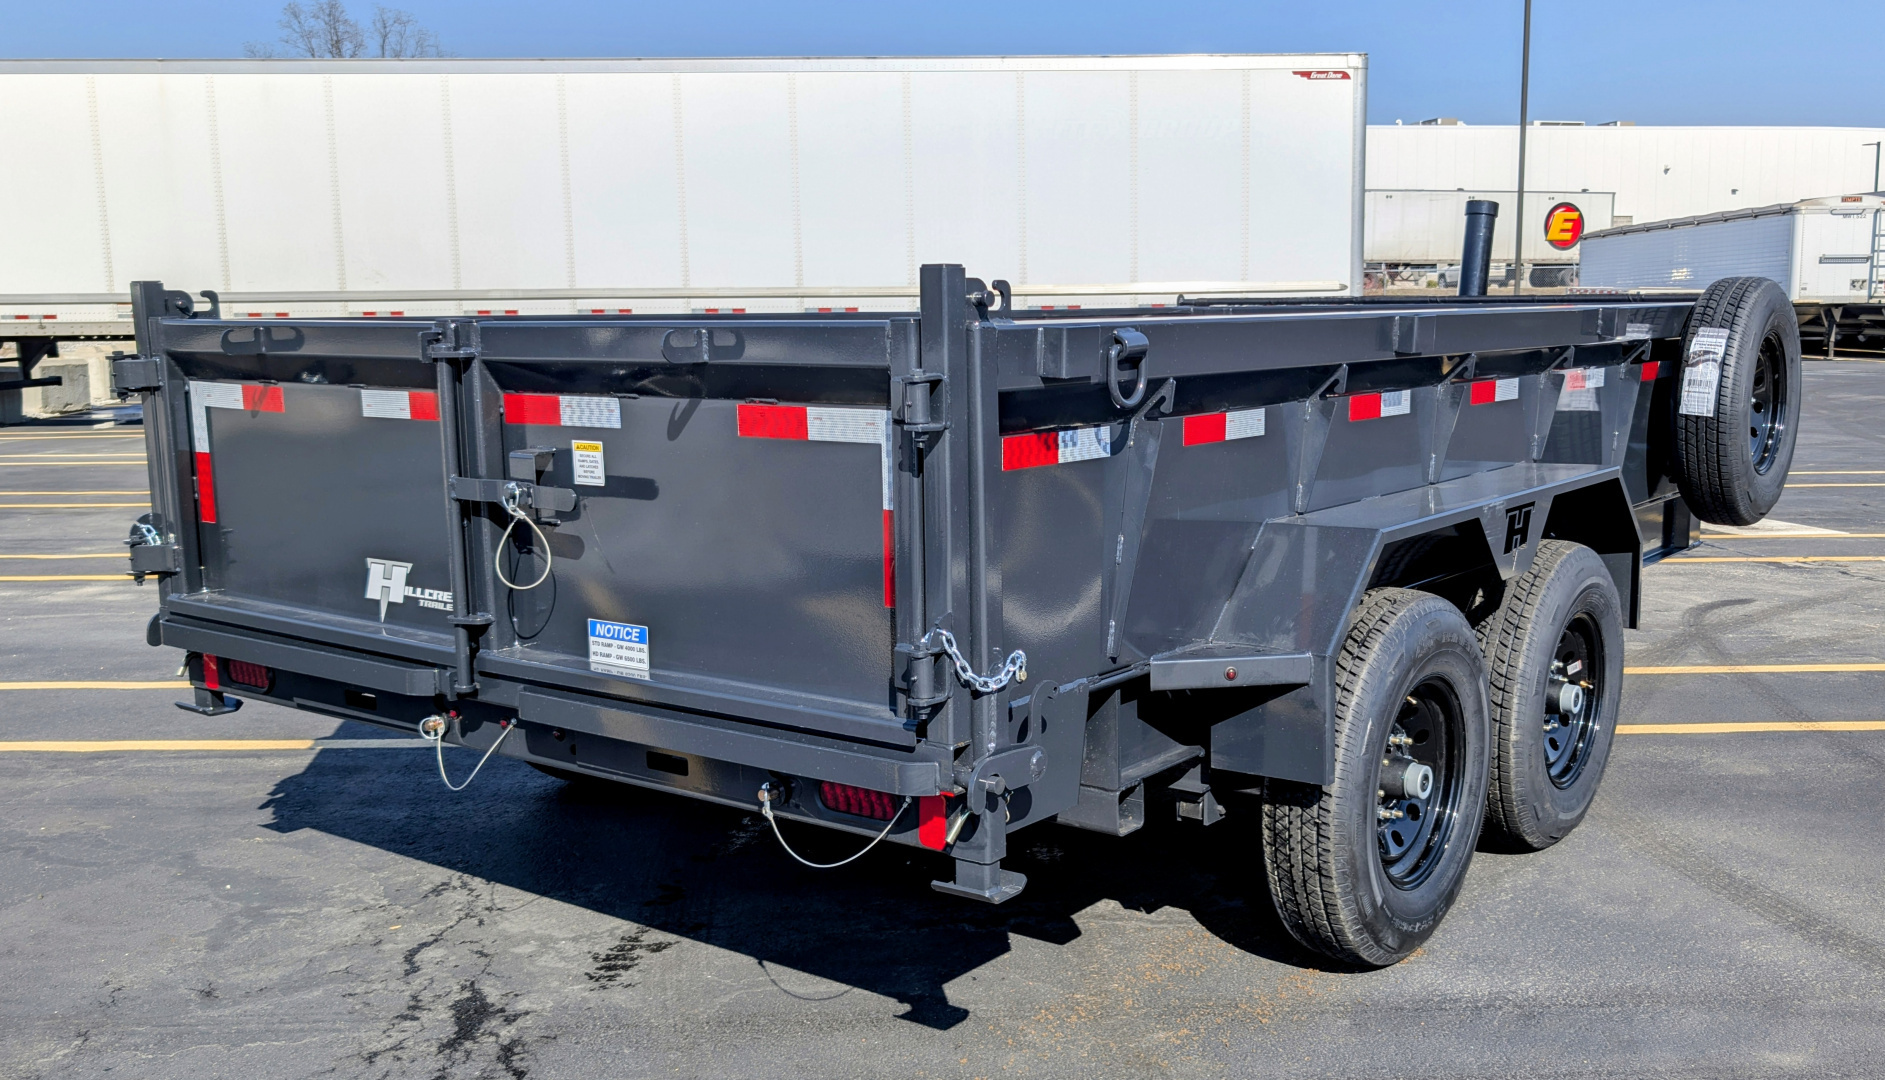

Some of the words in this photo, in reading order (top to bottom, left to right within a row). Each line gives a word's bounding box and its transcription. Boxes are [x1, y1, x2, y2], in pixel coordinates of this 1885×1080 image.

[1545, 211, 1580, 241] E
[418, 599, 454, 611] TRAILE
[596, 624, 640, 641] NOTICE
